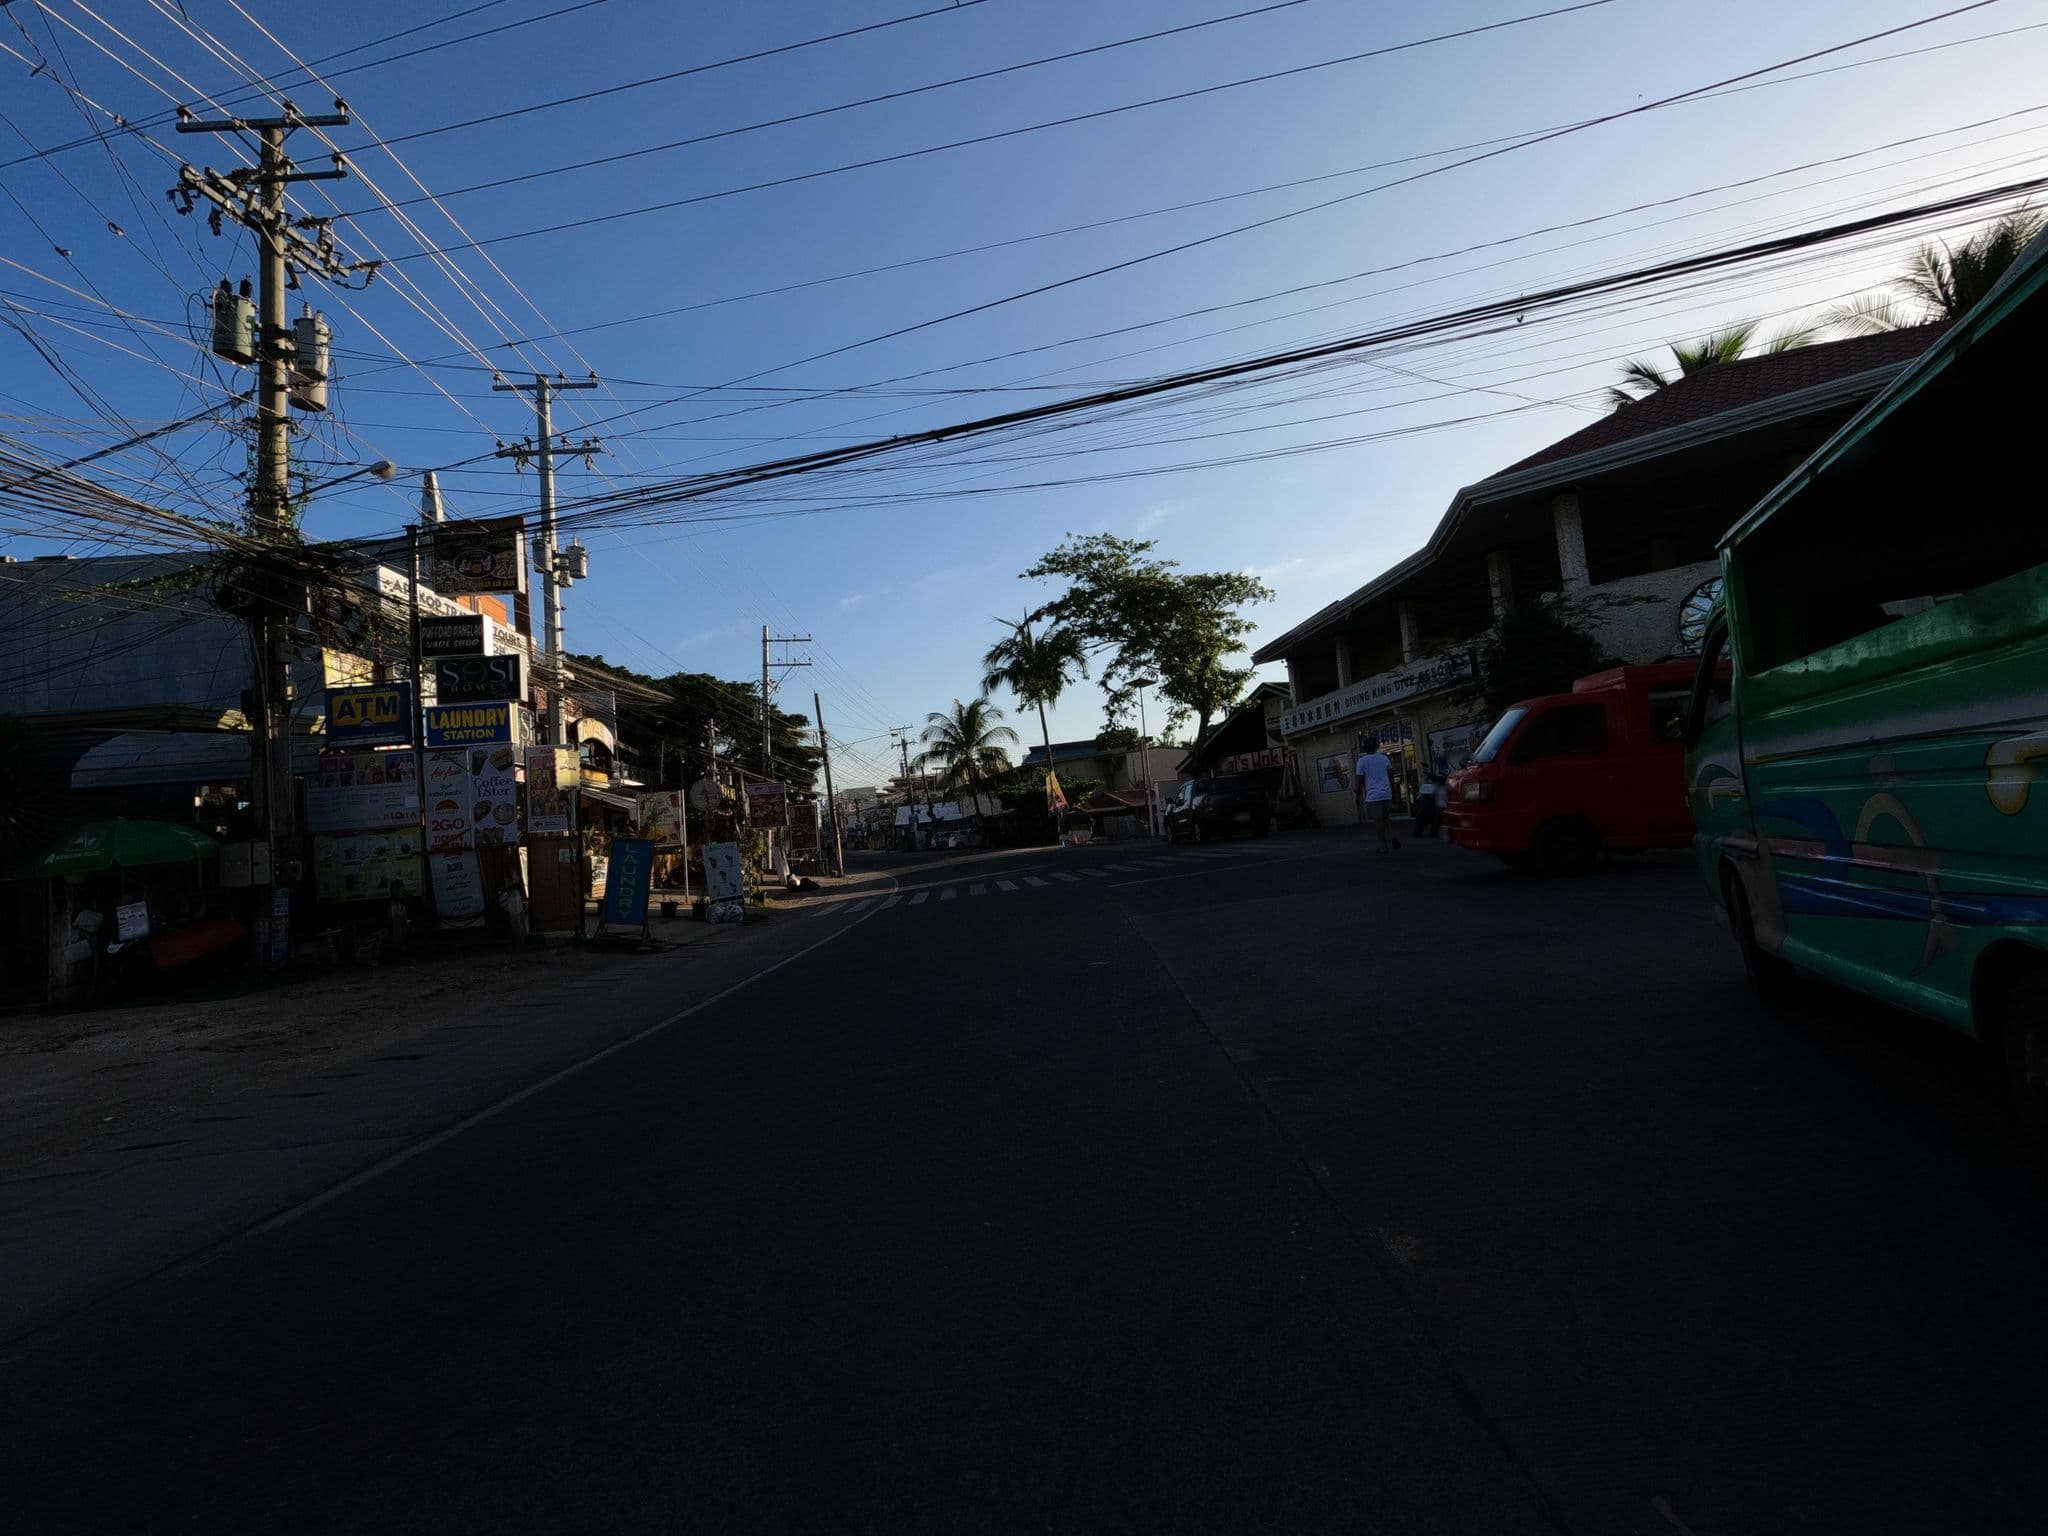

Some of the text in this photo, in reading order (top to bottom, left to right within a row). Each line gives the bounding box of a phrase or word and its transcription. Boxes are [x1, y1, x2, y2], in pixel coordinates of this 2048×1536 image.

[1344, 691, 1370, 708] DIVING
[1372, 682, 1392, 699] KING
[1394, 674, 1415, 691] DIVE
[337, 696, 398, 719] ATM
[430, 707, 508, 730] LAUNDRY
[442, 729, 496, 741] STATION
[1251, 750, 1279, 769] Wok
[474, 775, 514, 788] Coffee
[616, 842, 641, 921] LAUNDRY
